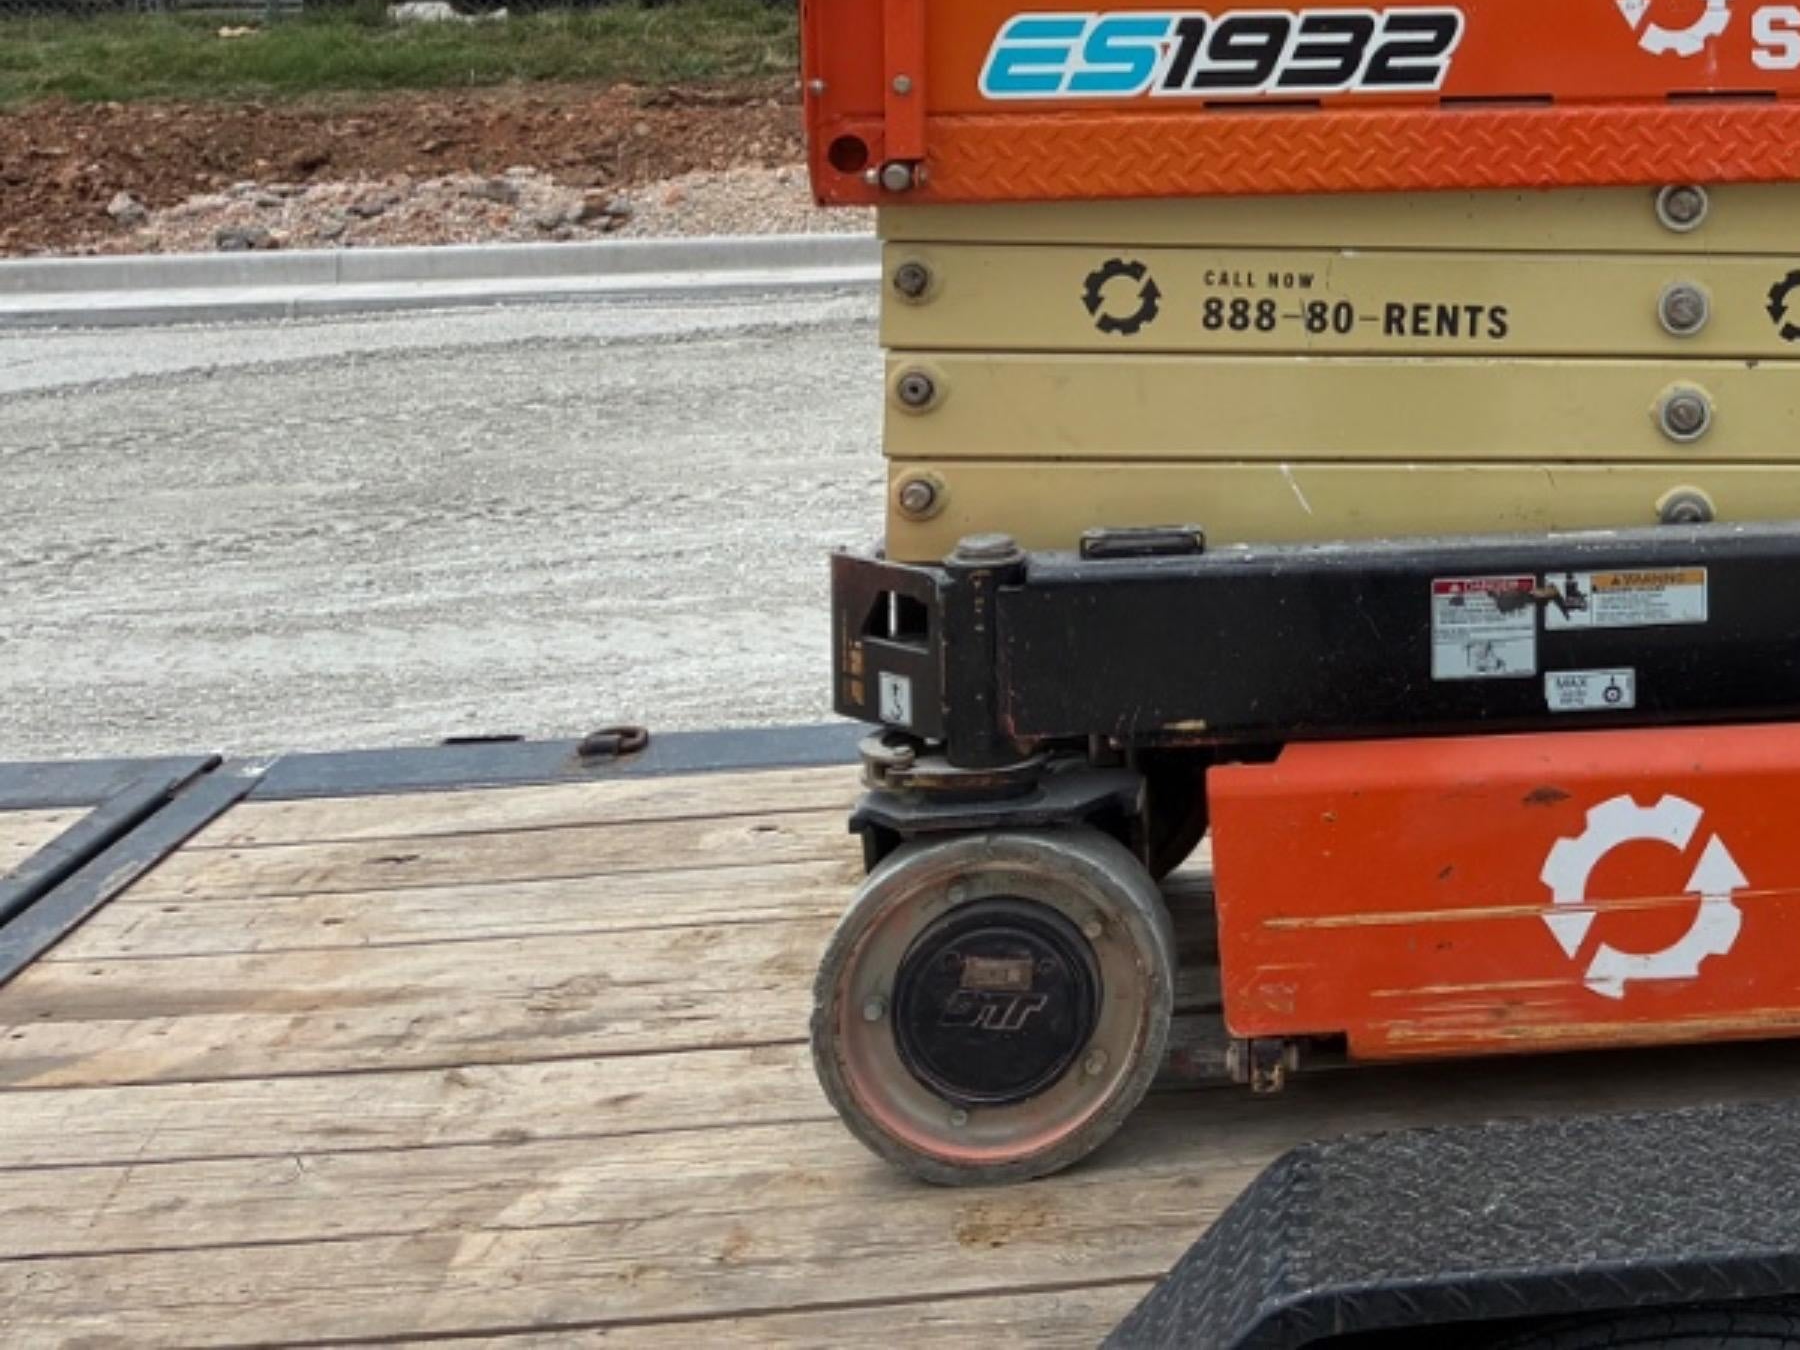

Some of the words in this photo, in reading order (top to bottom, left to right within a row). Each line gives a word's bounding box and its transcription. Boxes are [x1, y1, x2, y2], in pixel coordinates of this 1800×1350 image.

[980, 8, 1465, 98] ES1932
[1204, 269, 1256, 288] CALL
[1268, 271, 1315, 290] NOW
[1202, 296, 1508, 340] 888-80-RENTS
